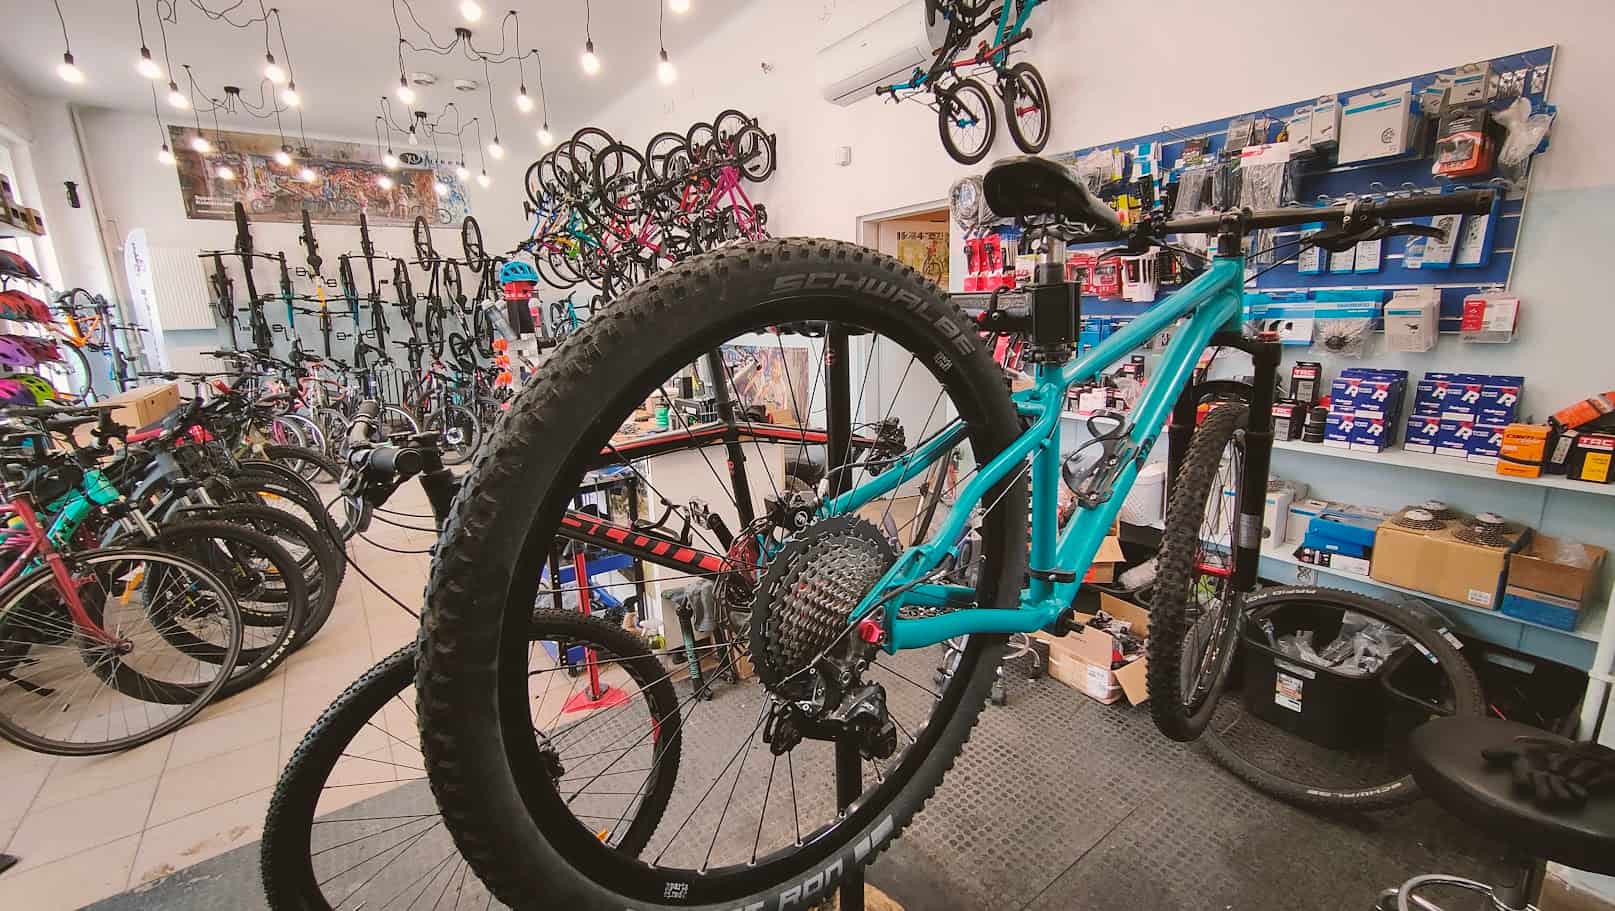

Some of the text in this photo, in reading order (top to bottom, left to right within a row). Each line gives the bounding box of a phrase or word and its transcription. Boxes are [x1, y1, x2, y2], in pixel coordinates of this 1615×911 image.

[771, 272, 976, 356] SCHWALBE
[1345, 384, 1359, 398] R
[1372, 388, 1389, 402] R
[1432, 386, 1448, 400] R
[1461, 390, 1480, 404] R
[1497, 392, 1517, 407] R
[1338, 420, 1354, 433] R
[1366, 423, 1384, 437] R
[1422, 422, 1440, 437] R
[1455, 425, 1473, 440] R
[260, 629, 296, 669] MAXXIS
